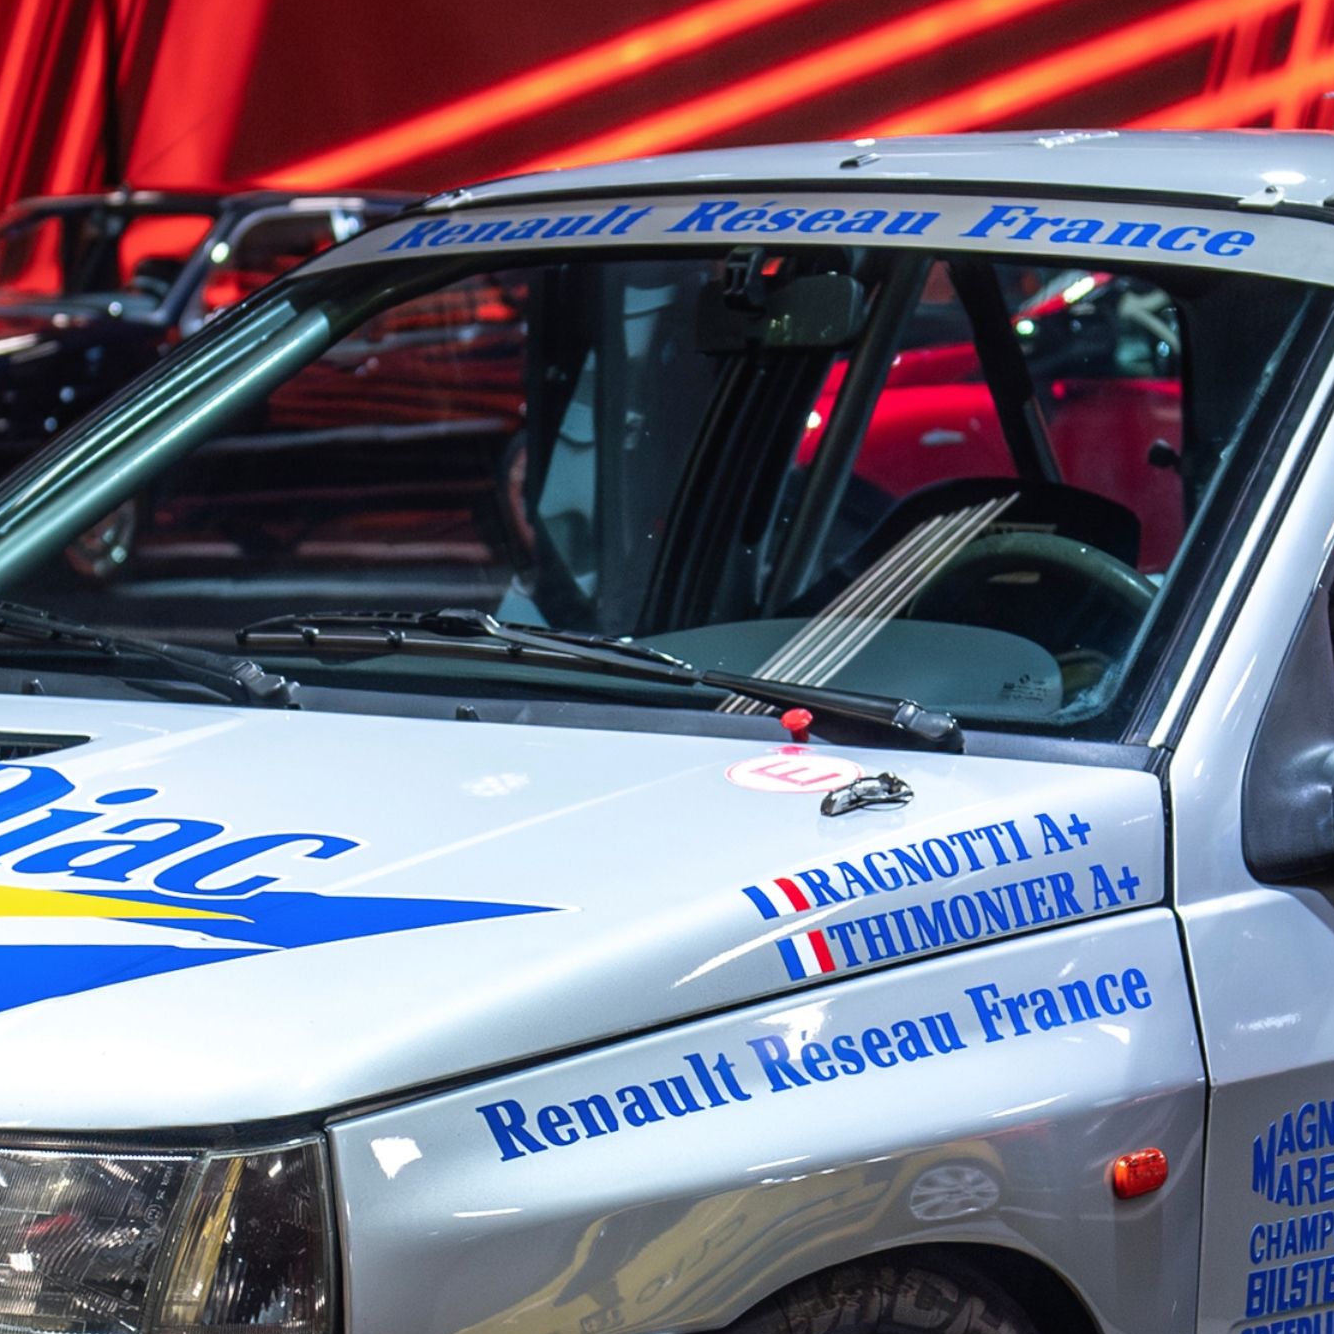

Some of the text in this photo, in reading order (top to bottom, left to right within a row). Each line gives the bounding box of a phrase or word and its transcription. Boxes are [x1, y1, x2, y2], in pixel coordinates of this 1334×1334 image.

[381, 199, 1255, 257] Renault Réseau France
[749, 760, 842, 787] E
[795, 813, 1092, 908] RAGNOTTI A+
[828, 864, 1141, 968] THIMONIER A+
[475, 967, 1154, 1163] Renault Réseau France
